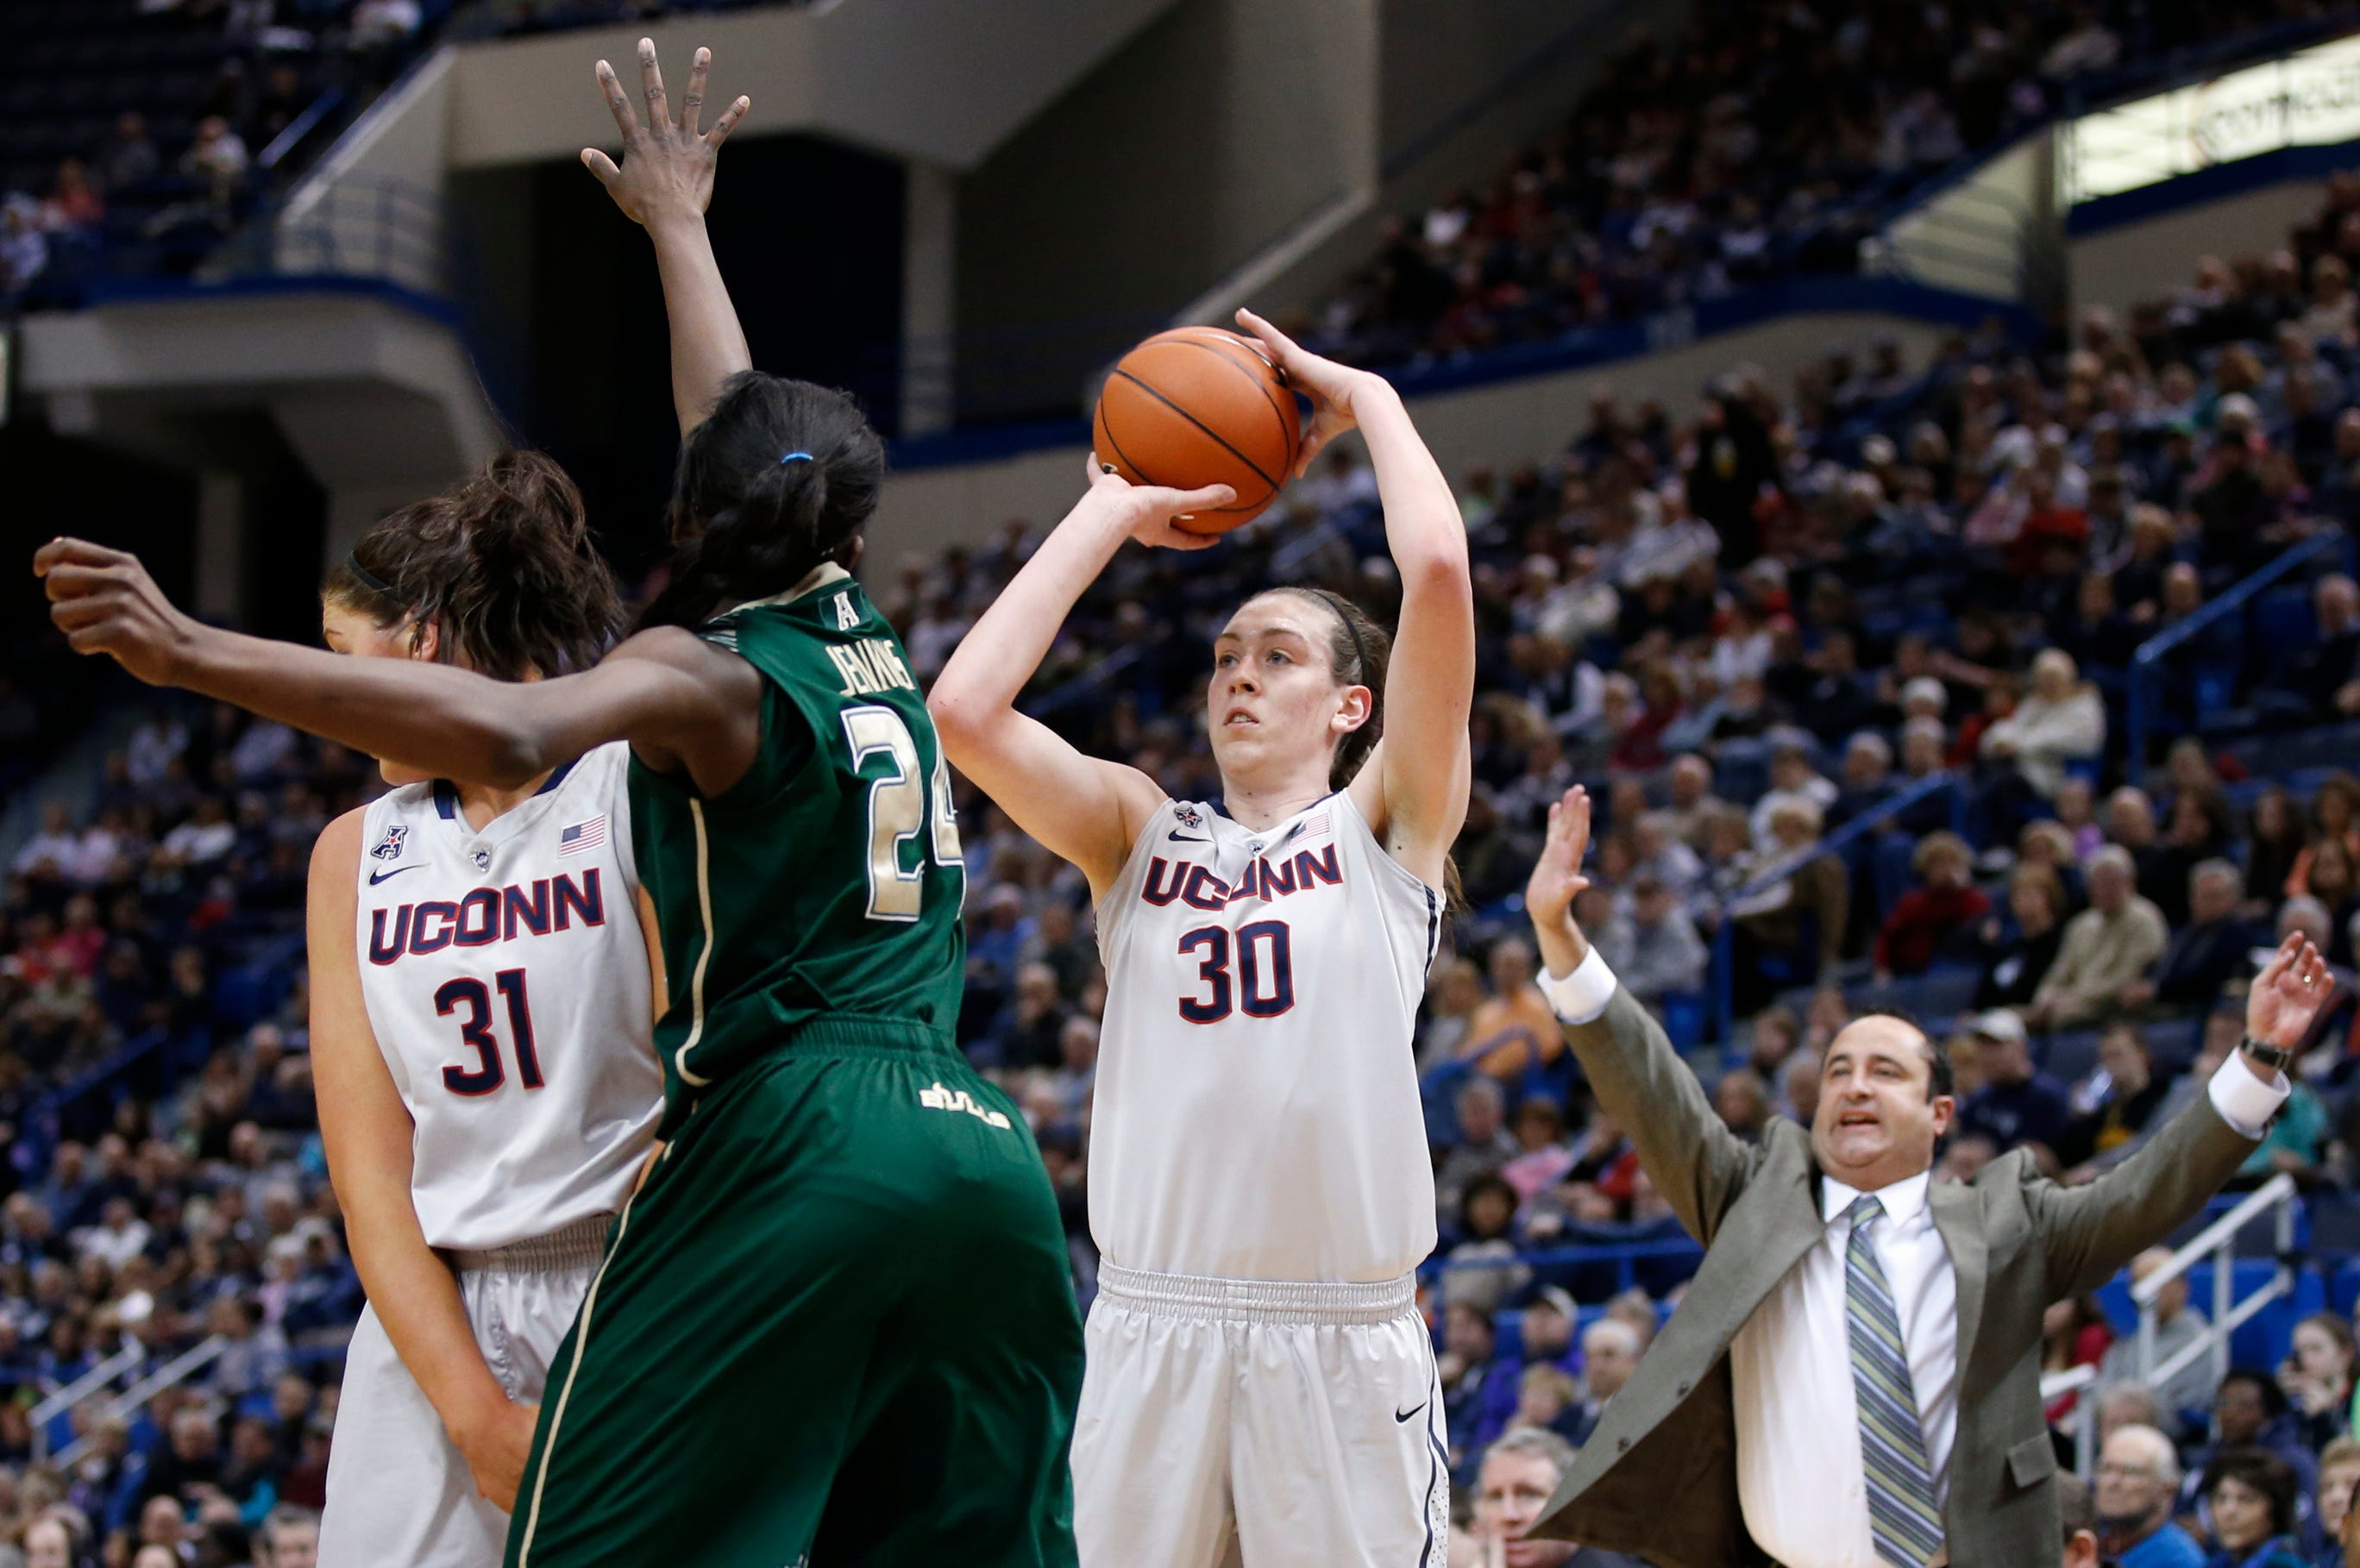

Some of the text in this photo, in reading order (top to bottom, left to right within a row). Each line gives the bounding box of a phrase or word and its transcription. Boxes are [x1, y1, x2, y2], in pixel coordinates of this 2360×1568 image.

[369, 868, 606, 965] UCONN
[1141, 843, 1343, 911] UCONN
[1178, 919, 1295, 1025] 30
[433, 968, 545, 1095] 31
